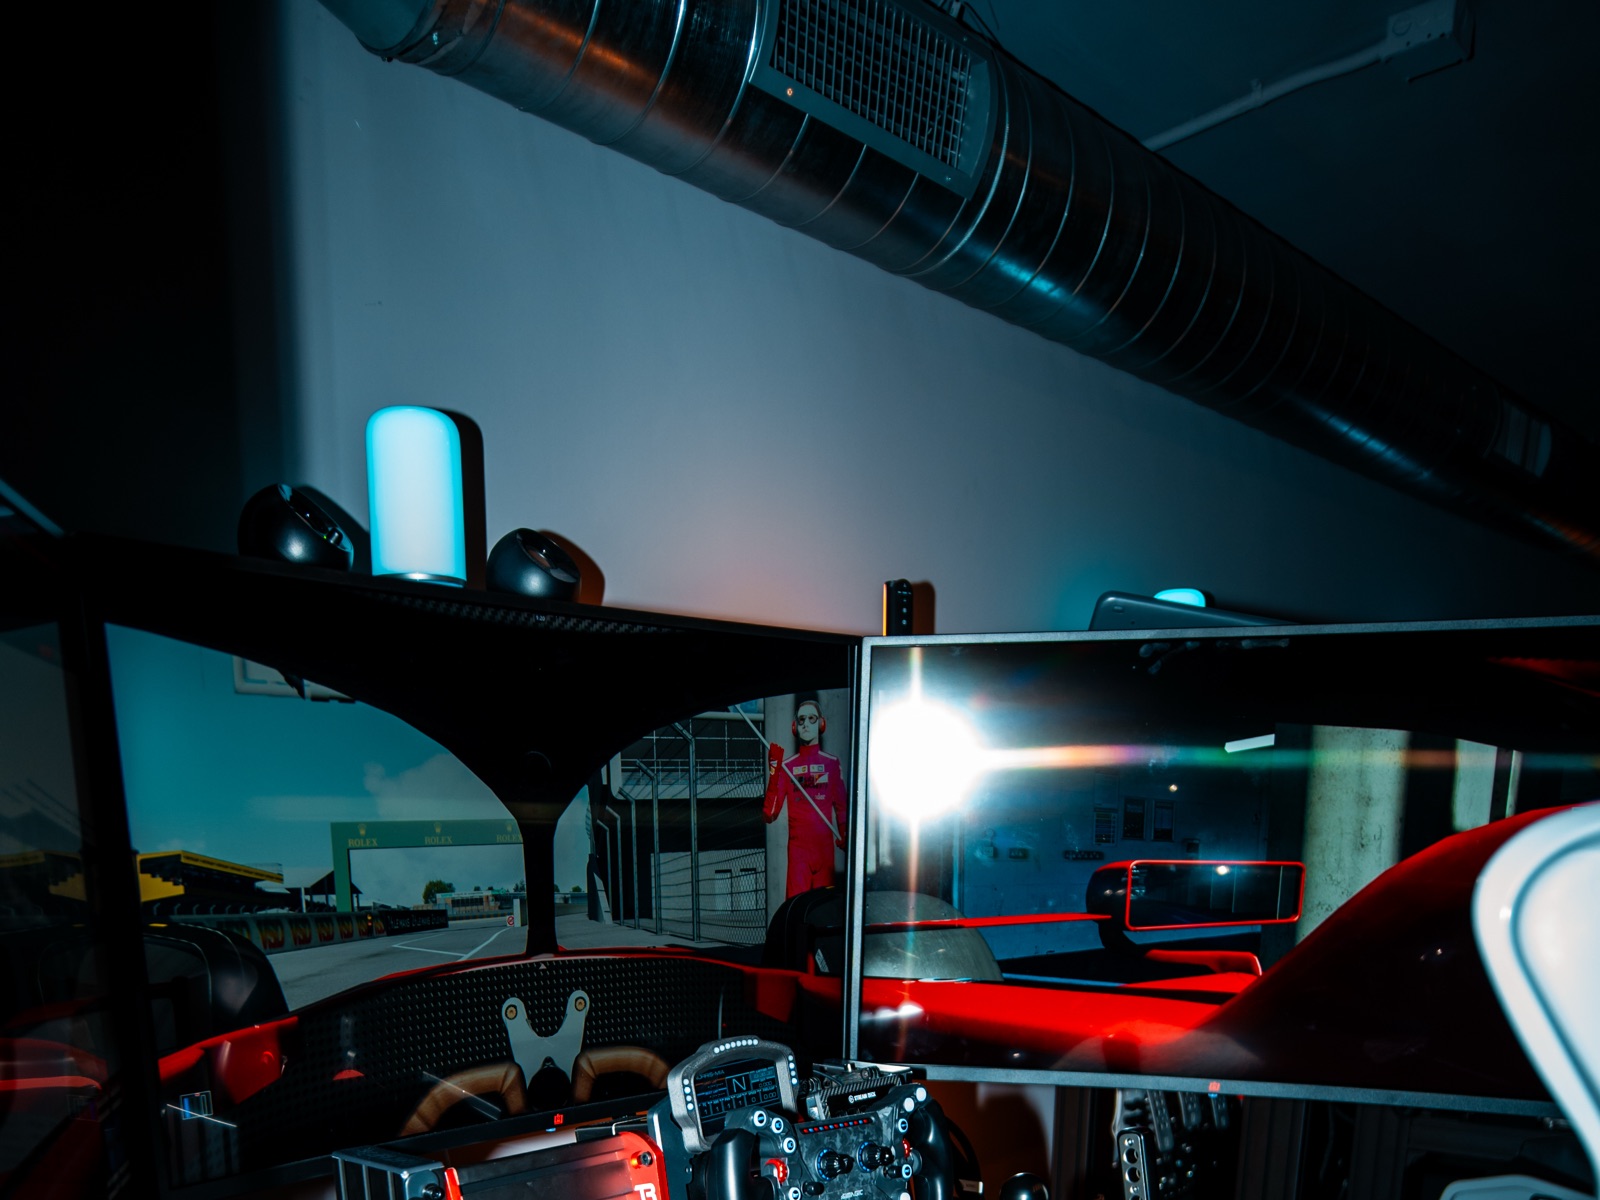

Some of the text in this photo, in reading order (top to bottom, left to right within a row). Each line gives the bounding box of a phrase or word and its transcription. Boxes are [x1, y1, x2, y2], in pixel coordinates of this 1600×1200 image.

[347, 838, 378, 847] ROLEX
[424, 835, 453, 844] ROLEX
[732, 1076, 747, 1093] N
